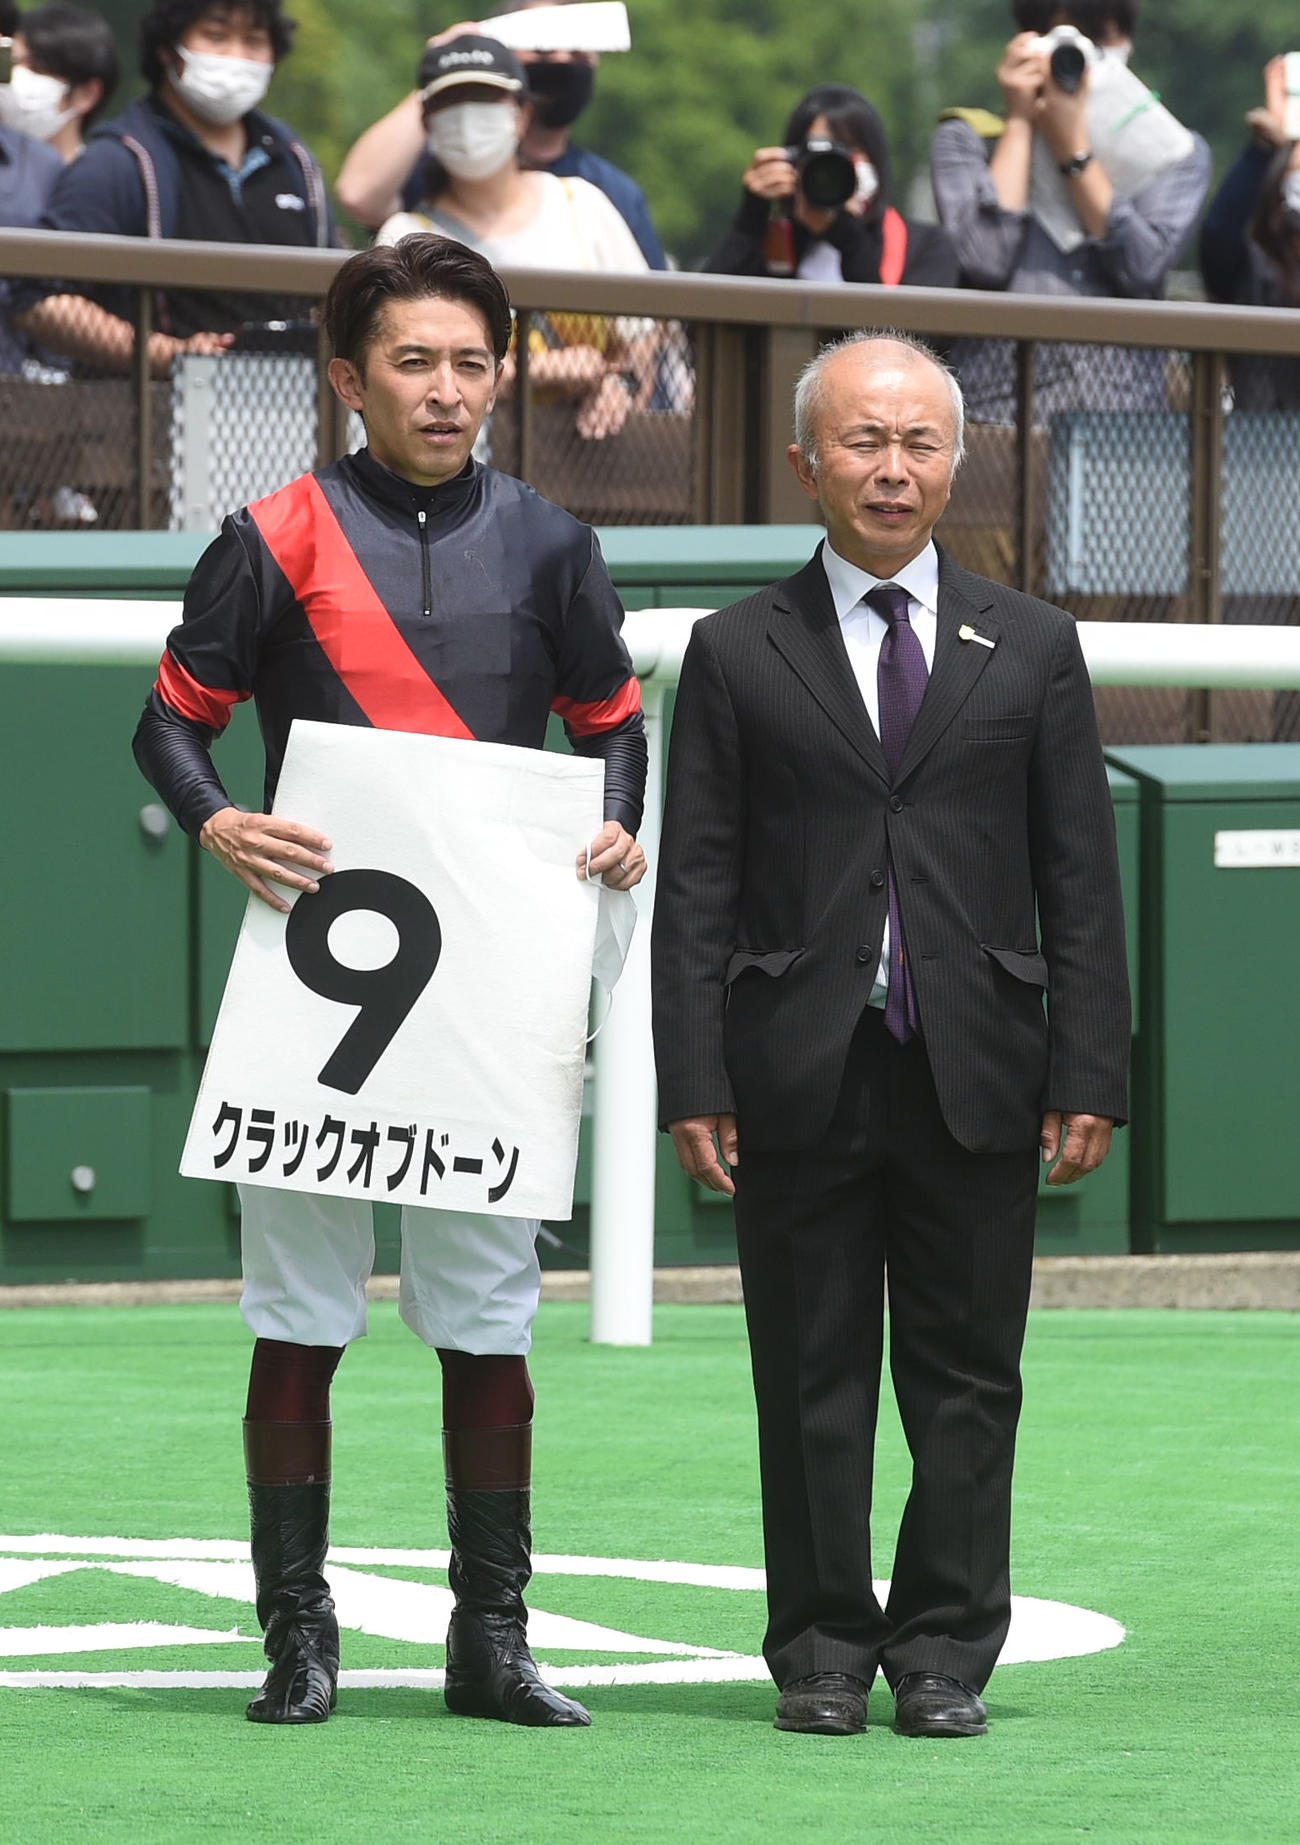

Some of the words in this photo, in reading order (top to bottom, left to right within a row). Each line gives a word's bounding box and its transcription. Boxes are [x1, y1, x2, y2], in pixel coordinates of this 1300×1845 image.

[285, 868, 442, 1096] 9
[212, 1101, 520, 1204] クラックオブドーン
